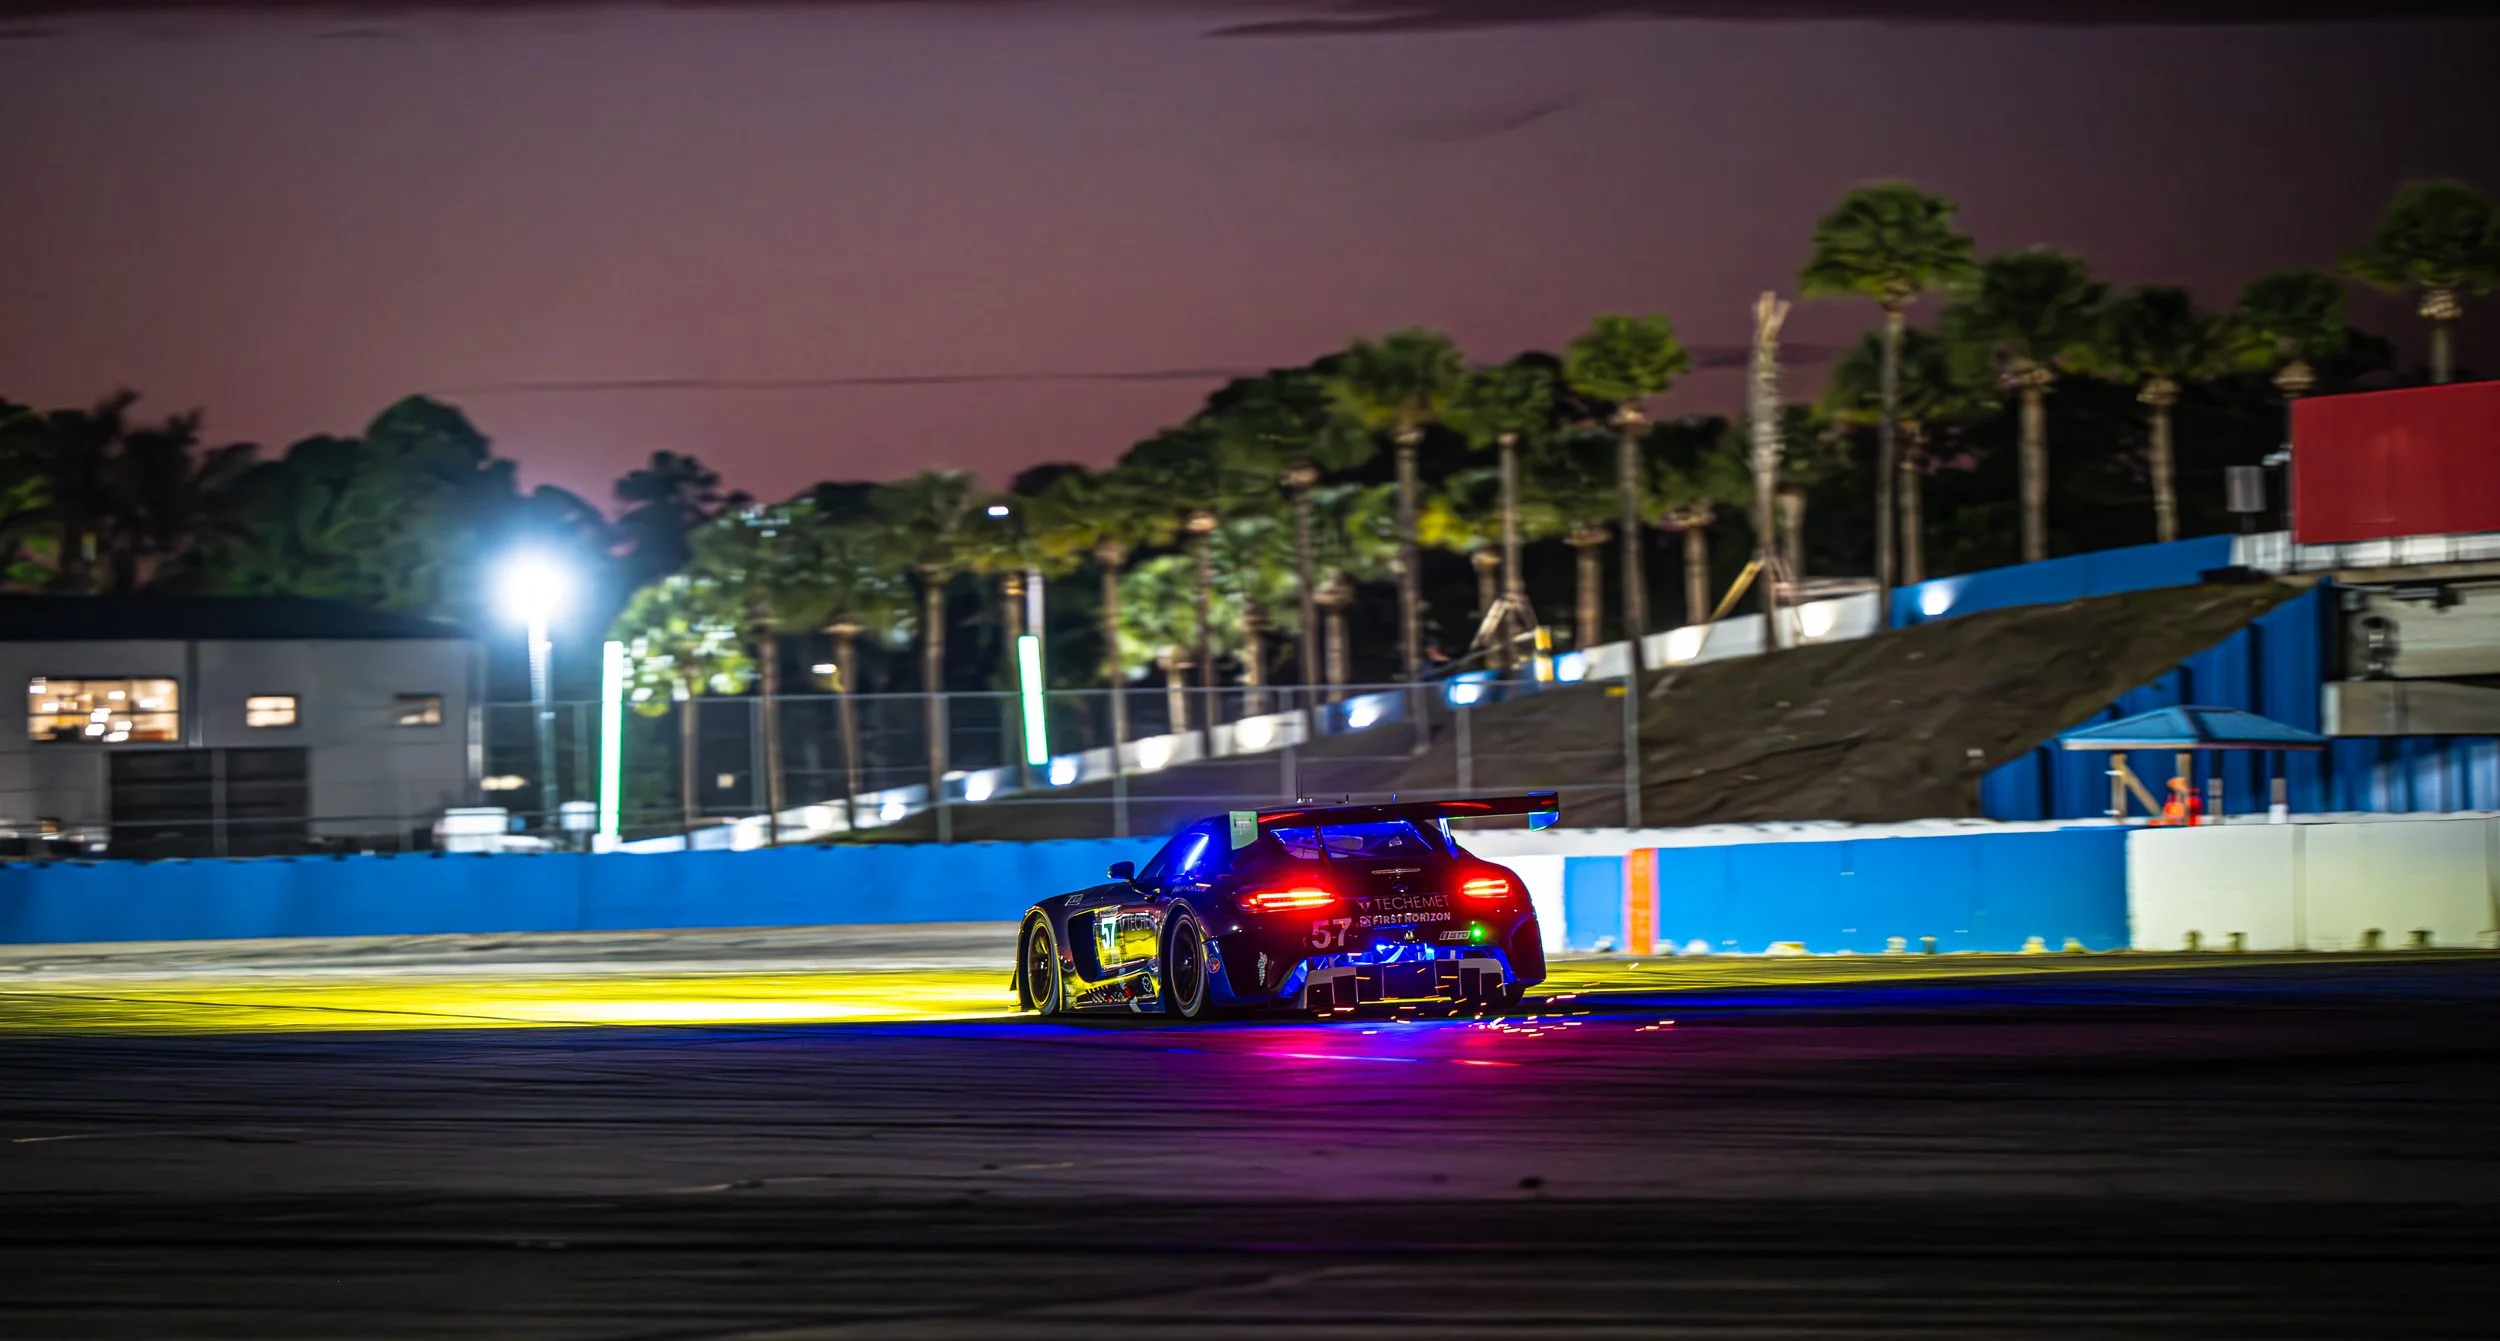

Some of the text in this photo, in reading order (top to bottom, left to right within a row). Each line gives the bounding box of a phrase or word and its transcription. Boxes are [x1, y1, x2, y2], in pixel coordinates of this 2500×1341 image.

[1375, 895, 1449, 910] TECHEMET
[1373, 911, 1451, 925] FIRST HORIZON
[1102, 917, 1116, 950] 57
[1312, 917, 1352, 949] 57
